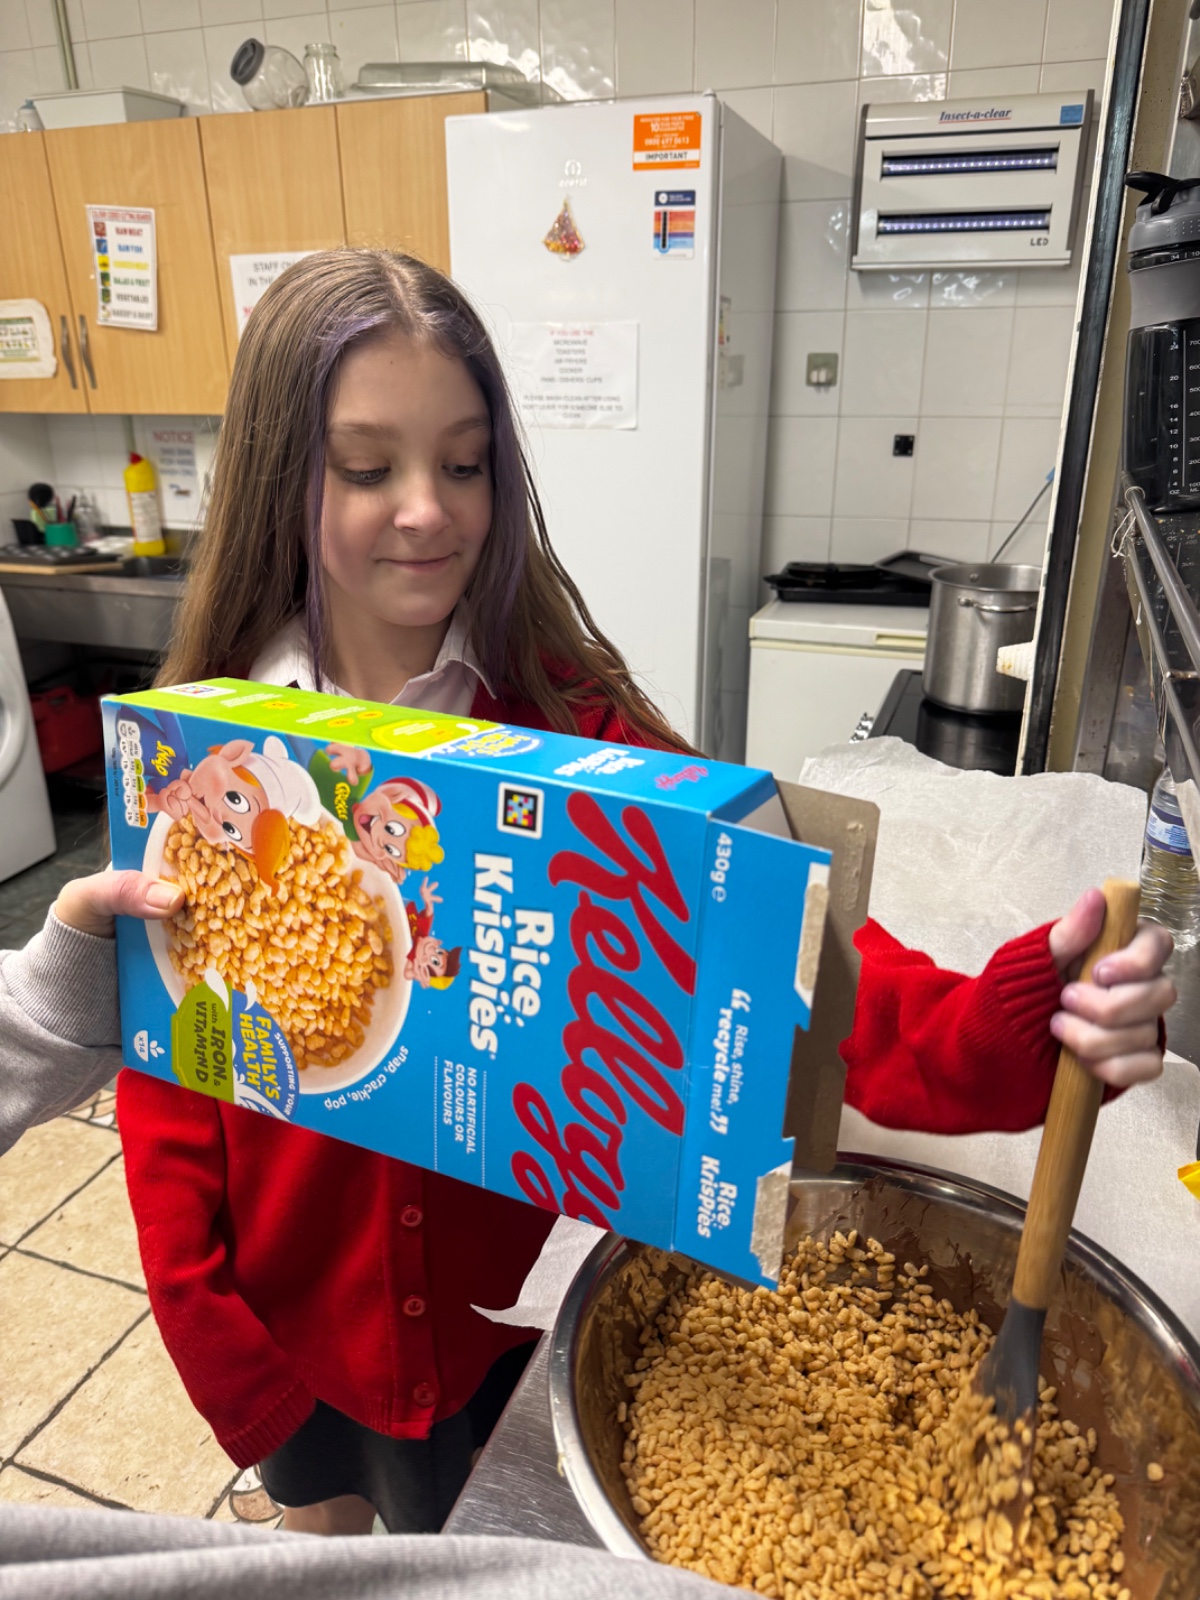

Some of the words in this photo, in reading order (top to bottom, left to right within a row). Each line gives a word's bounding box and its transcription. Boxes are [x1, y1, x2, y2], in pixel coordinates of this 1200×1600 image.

[939, 109, 1012, 121] Insect-a-clear
[645, 151, 688, 160] IMPORTANT
[253, 260, 278, 272] STAFF
[1030, 238, 1049, 247] LED
[153, 430, 195, 444] NOTICE
[709, 832, 733, 884] 430g
[468, 852, 514, 1053] Krispies
[510, 908, 555, 1018] Rice
[194, 1001, 209, 1069] VITAMIN
[211, 1027, 228, 1082] IRON
[255, 1015, 282, 1100] FAMILY'S
[713, 1007, 733, 1084] recycle
[195, 1069, 209, 1083] D
[274, 1032, 296, 1091] SUPPORTING
[467, 1066, 478, 1087] NO
[283, 1092, 296, 1116] YOUR
[323, 1094, 348, 1110] pop
[443, 1059, 454, 1126] FLAVOURS
[455, 1063, 465, 1123] COLOURS
[454, 1123, 465, 1143] OR
[466, 1087, 477, 1155] ARTIFICIAL
[697, 1154, 720, 1239] Krispies
[716, 1180, 738, 1228] Rice
